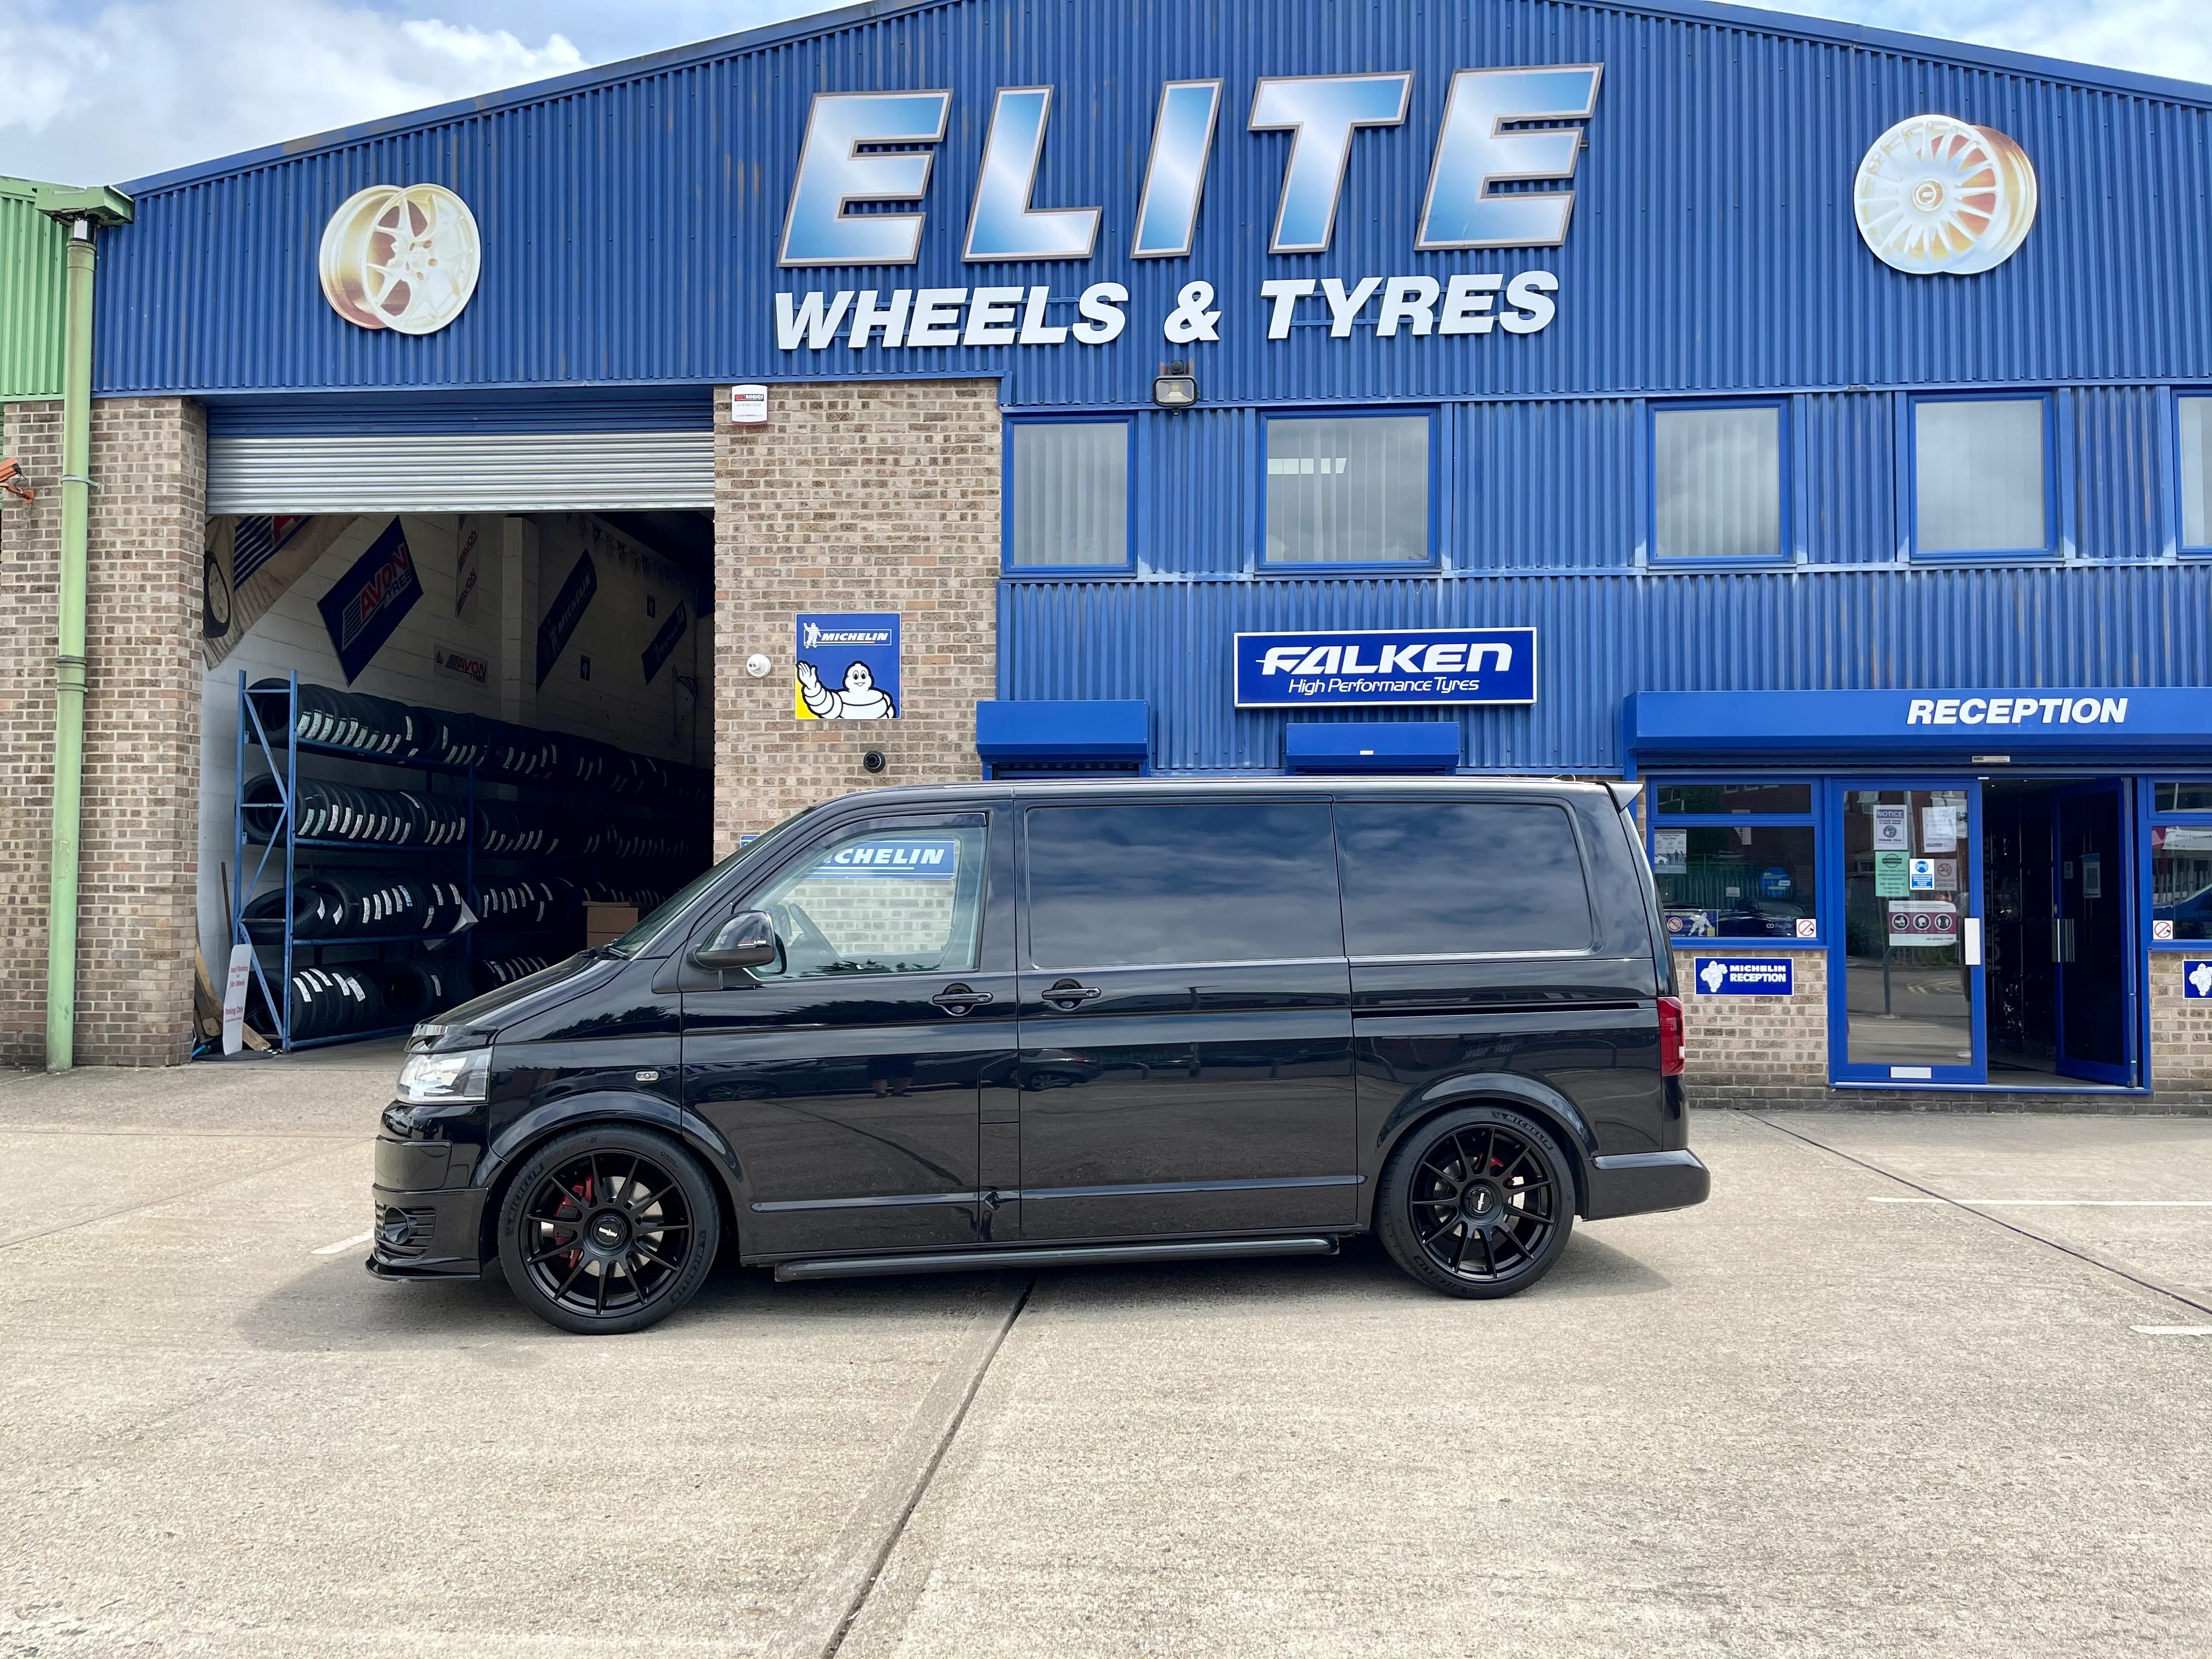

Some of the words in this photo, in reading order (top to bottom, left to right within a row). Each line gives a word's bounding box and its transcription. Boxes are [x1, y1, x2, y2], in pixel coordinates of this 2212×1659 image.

[776, 63, 1605, 267] ELITE
[775, 281, 1128, 350] WHEELS
[1164, 280, 1222, 344] &
[1260, 269, 1559, 339] TYRES
[360, 542, 410, 622] AVON
[383, 568, 412, 609] TYRES
[821, 633, 888, 641] MICHELIN
[456, 658, 487, 676] AVON
[1255, 642, 1513, 676] FALKEN
[1288, 678, 1325, 696] High
[1328, 677, 1432, 693] Performance
[1434, 676, 1480, 694] Tyres
[1906, 697, 2128, 725] RECEPTION
[823, 848, 945, 865] CHELIN
[1730, 973, 1786, 983] RECEPTION
[1506, 1114, 1553, 1150] MICHELIN
[508, 1164, 543, 1221] MICHELIN
